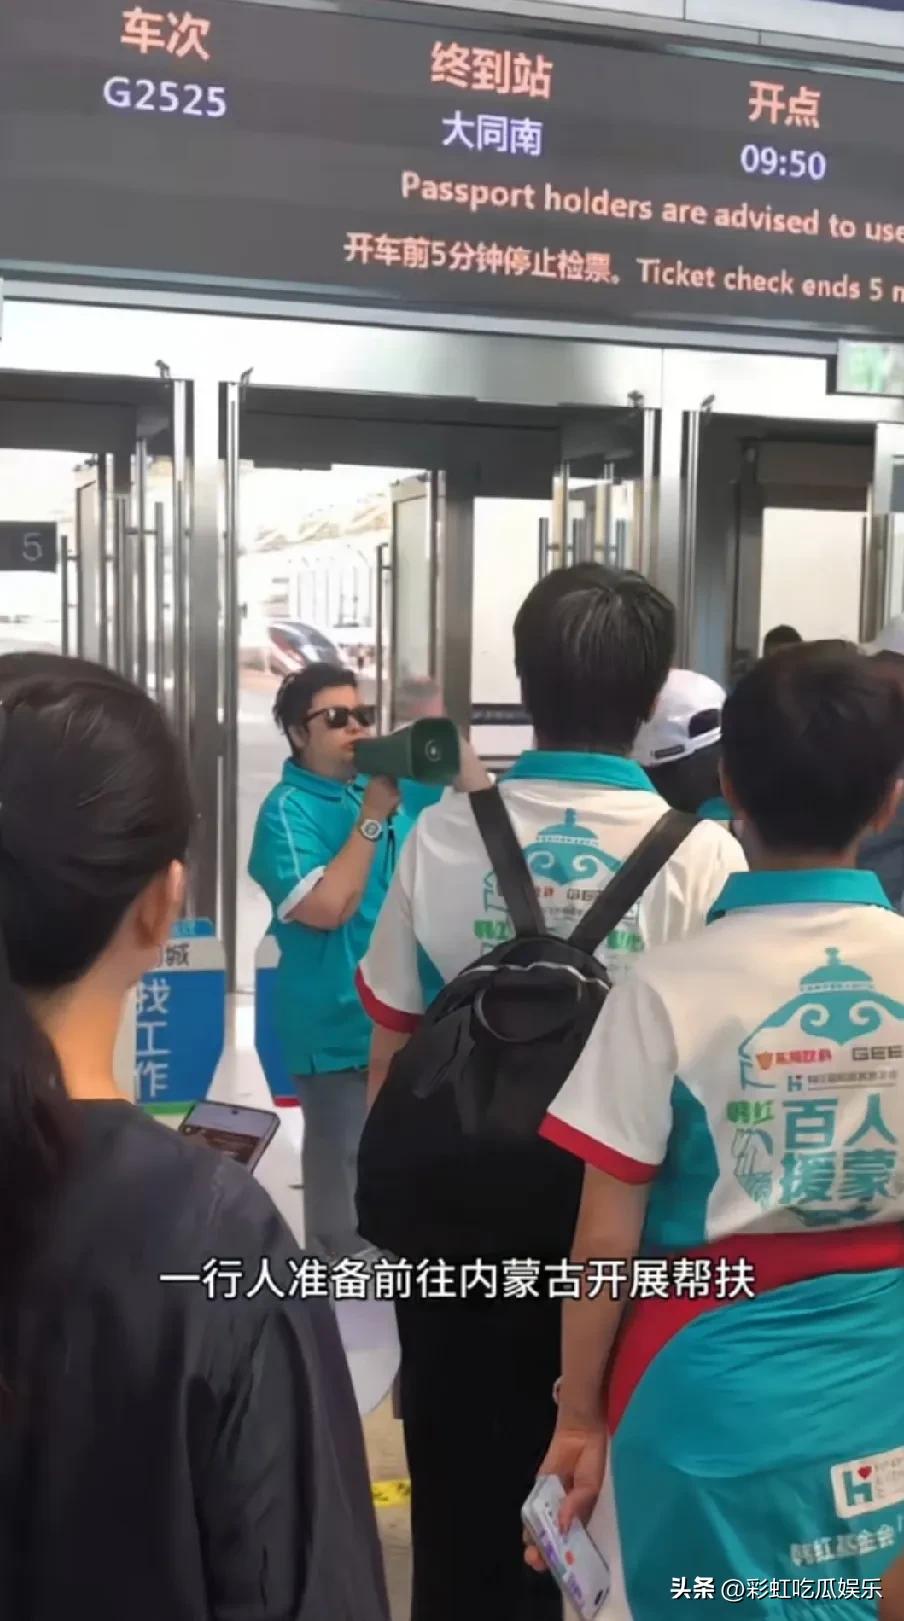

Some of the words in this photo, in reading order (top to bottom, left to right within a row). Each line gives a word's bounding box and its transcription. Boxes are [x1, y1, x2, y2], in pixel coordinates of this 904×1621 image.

[120, 6, 212, 61] 车次
[430, 41, 554, 99] 终到站
[103, 76, 227, 117] G2525
[748, 80, 821, 129] 开点
[441, 110, 544, 157] 大同南
[740, 144, 827, 181] 09:50
[401, 170, 535, 212] Passport
[544, 182, 653, 220] holders
[661, 200, 708, 226] are
[714, 203, 819, 236] advised
[829, 213, 856, 238] to
[865, 221, 904, 244] use
[343, 231, 621, 285] 开车前5分钟停止检票。
[636, 257, 715, 290] Ticket
[723, 263, 794, 296] check
[802, 273, 860, 300] ends
[869, 277, 883, 302] 5
[22, 532, 43, 562] 5
[134, 978, 172, 1099] 找工作
